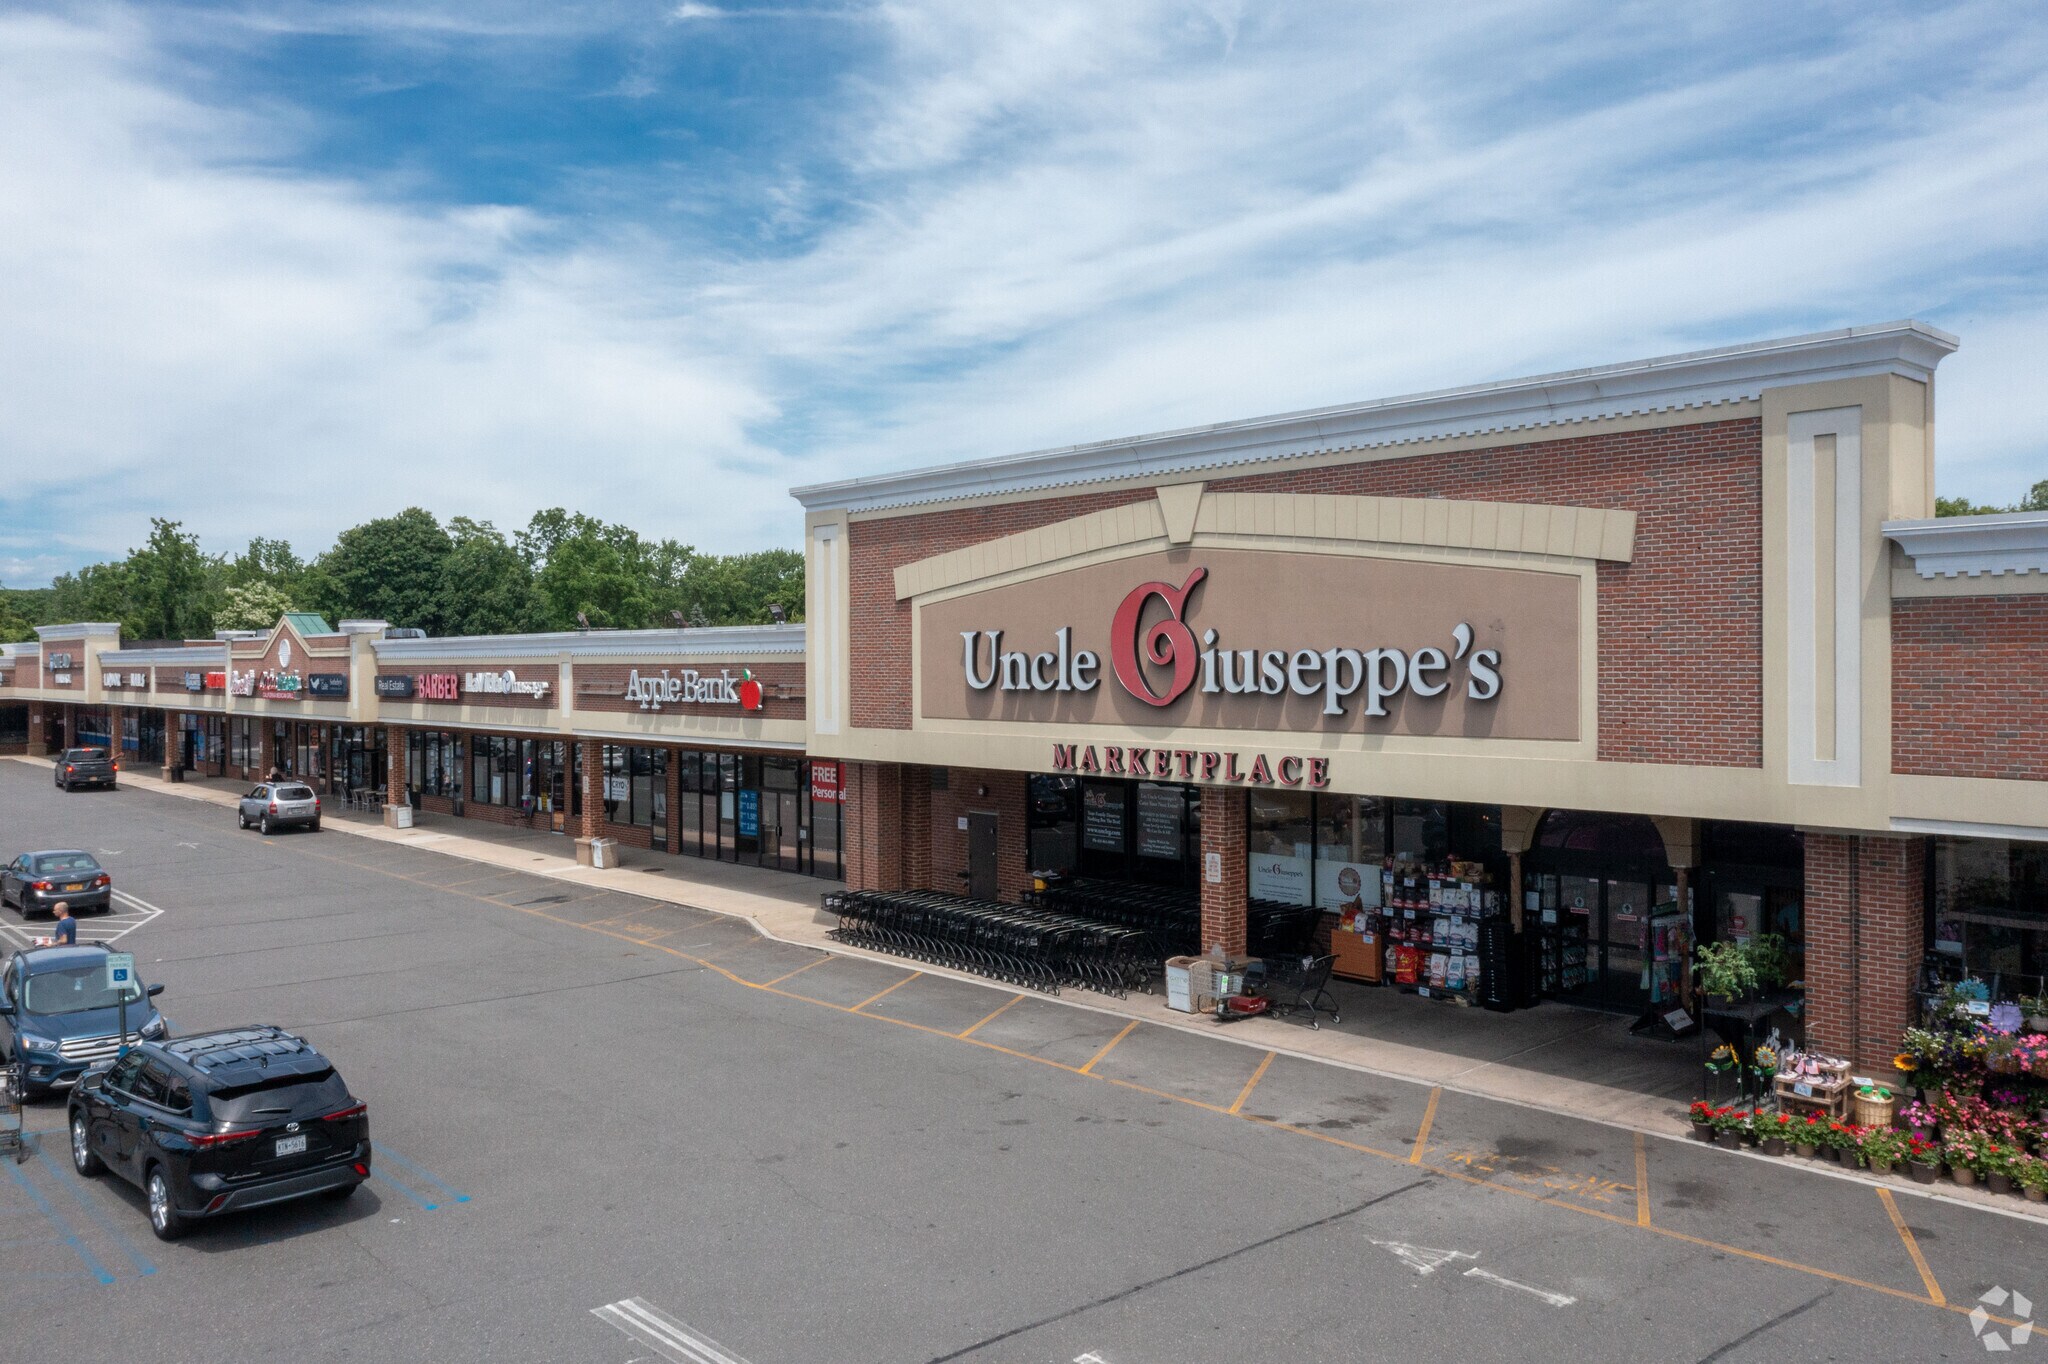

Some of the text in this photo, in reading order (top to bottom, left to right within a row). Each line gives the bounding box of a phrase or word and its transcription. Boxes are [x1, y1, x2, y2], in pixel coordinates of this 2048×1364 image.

[960, 567, 1503, 717] Uncle Giuseppe's
[378, 680, 405, 691] Real Estate
[418, 673, 460, 700] BARBER
[625, 669, 741, 710] Apple Bank
[812, 766, 837, 783] FREE
[1052, 743, 1330, 788] MARKETPLACE
[612, 780, 625, 790] CRYO
